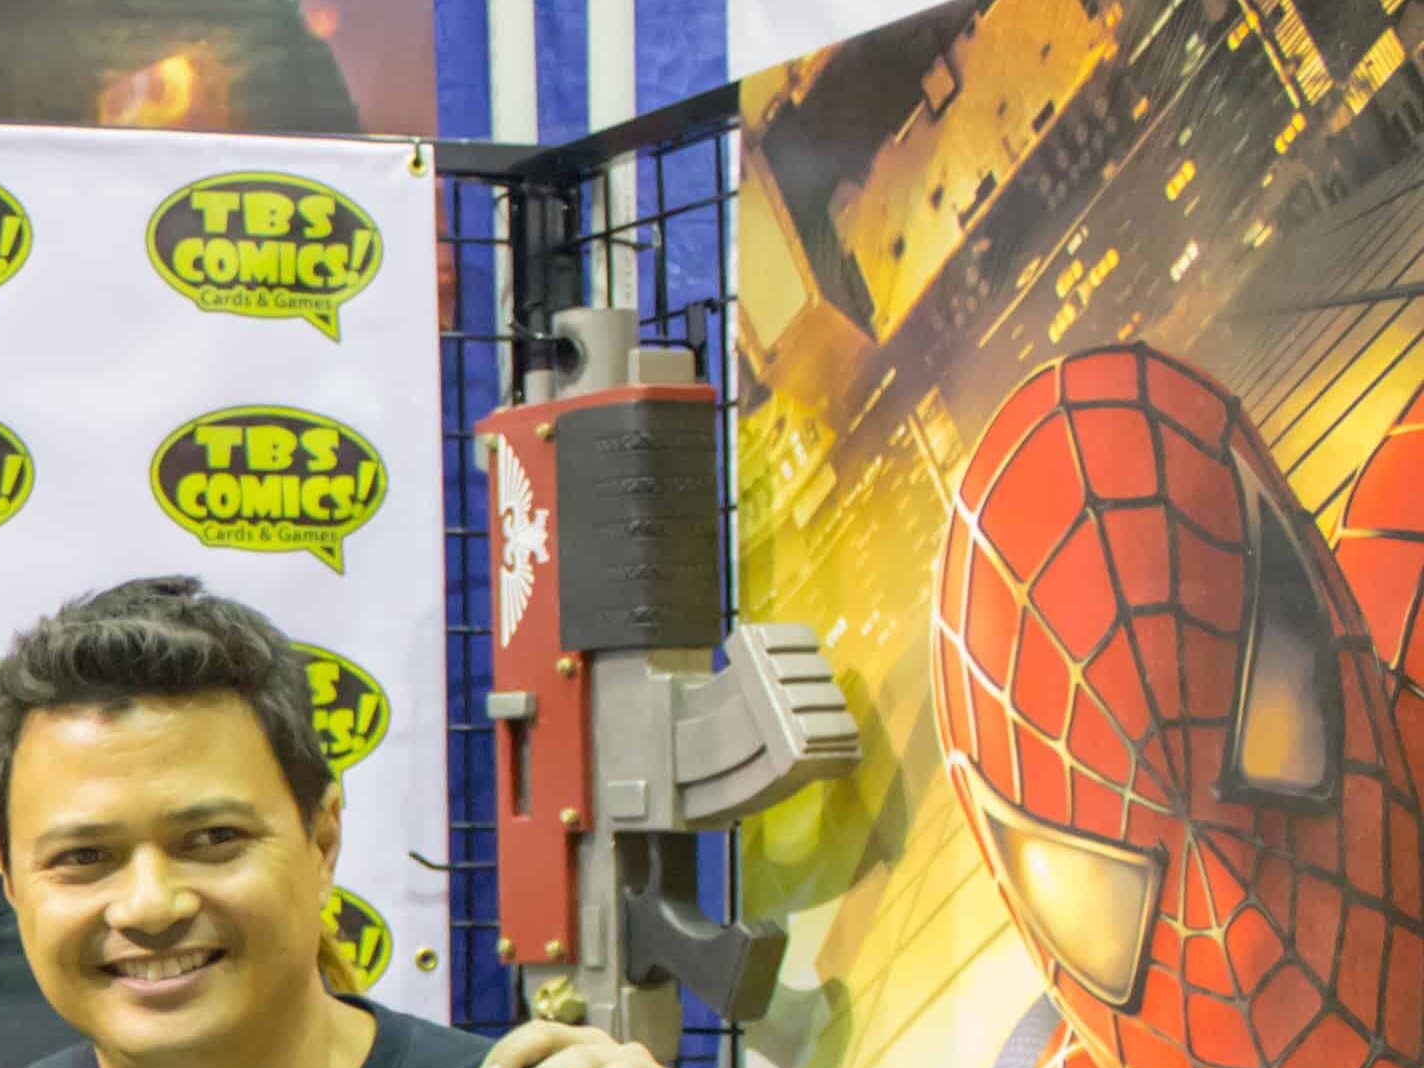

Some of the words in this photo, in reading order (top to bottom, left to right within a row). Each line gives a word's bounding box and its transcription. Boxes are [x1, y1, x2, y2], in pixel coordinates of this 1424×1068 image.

[190, 190, 336, 239] TBS
[173, 228, 372, 288] COMICS!
[199, 290, 249, 308] Cards
[254, 291, 267, 309] &
[272, 292, 333, 312] Games
[194, 425, 341, 472] TBS
[176, 460, 377, 520] COMICS!
[202, 524, 253, 542] Cards
[258, 525, 272, 542] &
[276, 526, 338, 544] Games
